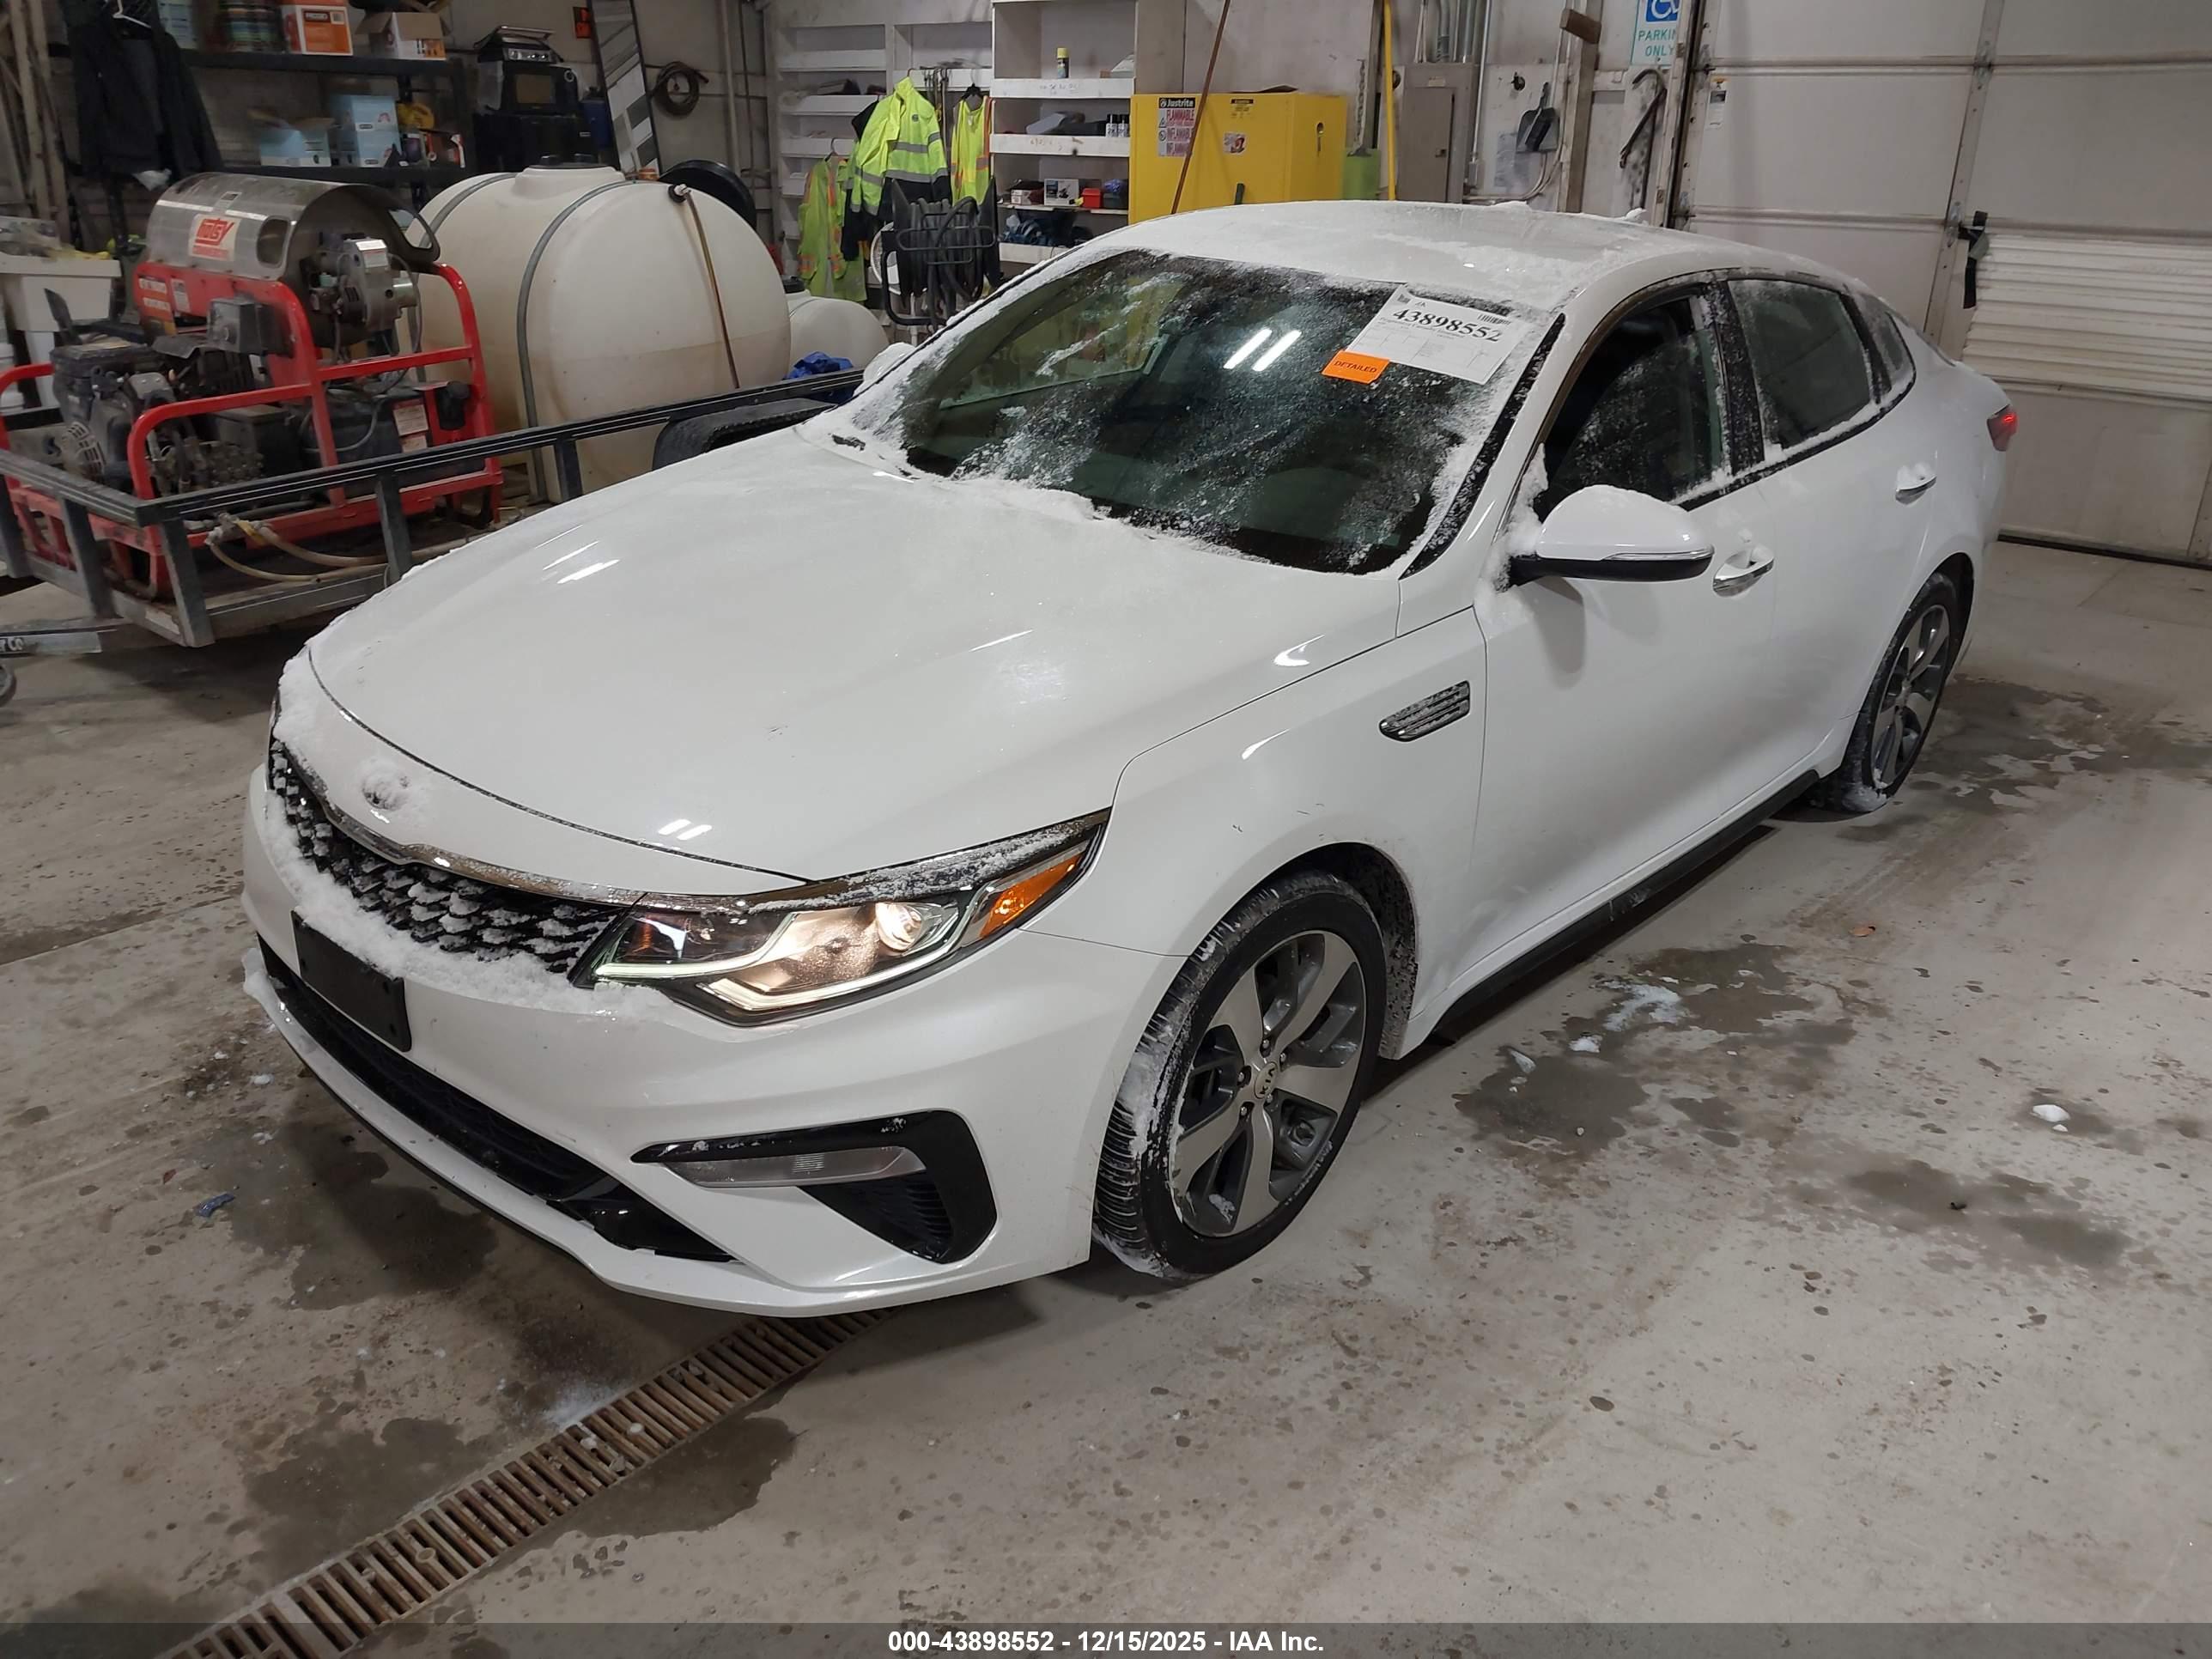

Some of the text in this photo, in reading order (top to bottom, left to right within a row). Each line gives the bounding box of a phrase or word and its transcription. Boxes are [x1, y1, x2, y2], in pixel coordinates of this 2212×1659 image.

[1644, 44, 1675, 57] ONLY
[1167, 98, 1194, 107] Justrite
[1392, 308, 1503, 343] 43898552
[1334, 360, 1377, 374] DETAILED
[1259, 1067, 1275, 1095] KIA
